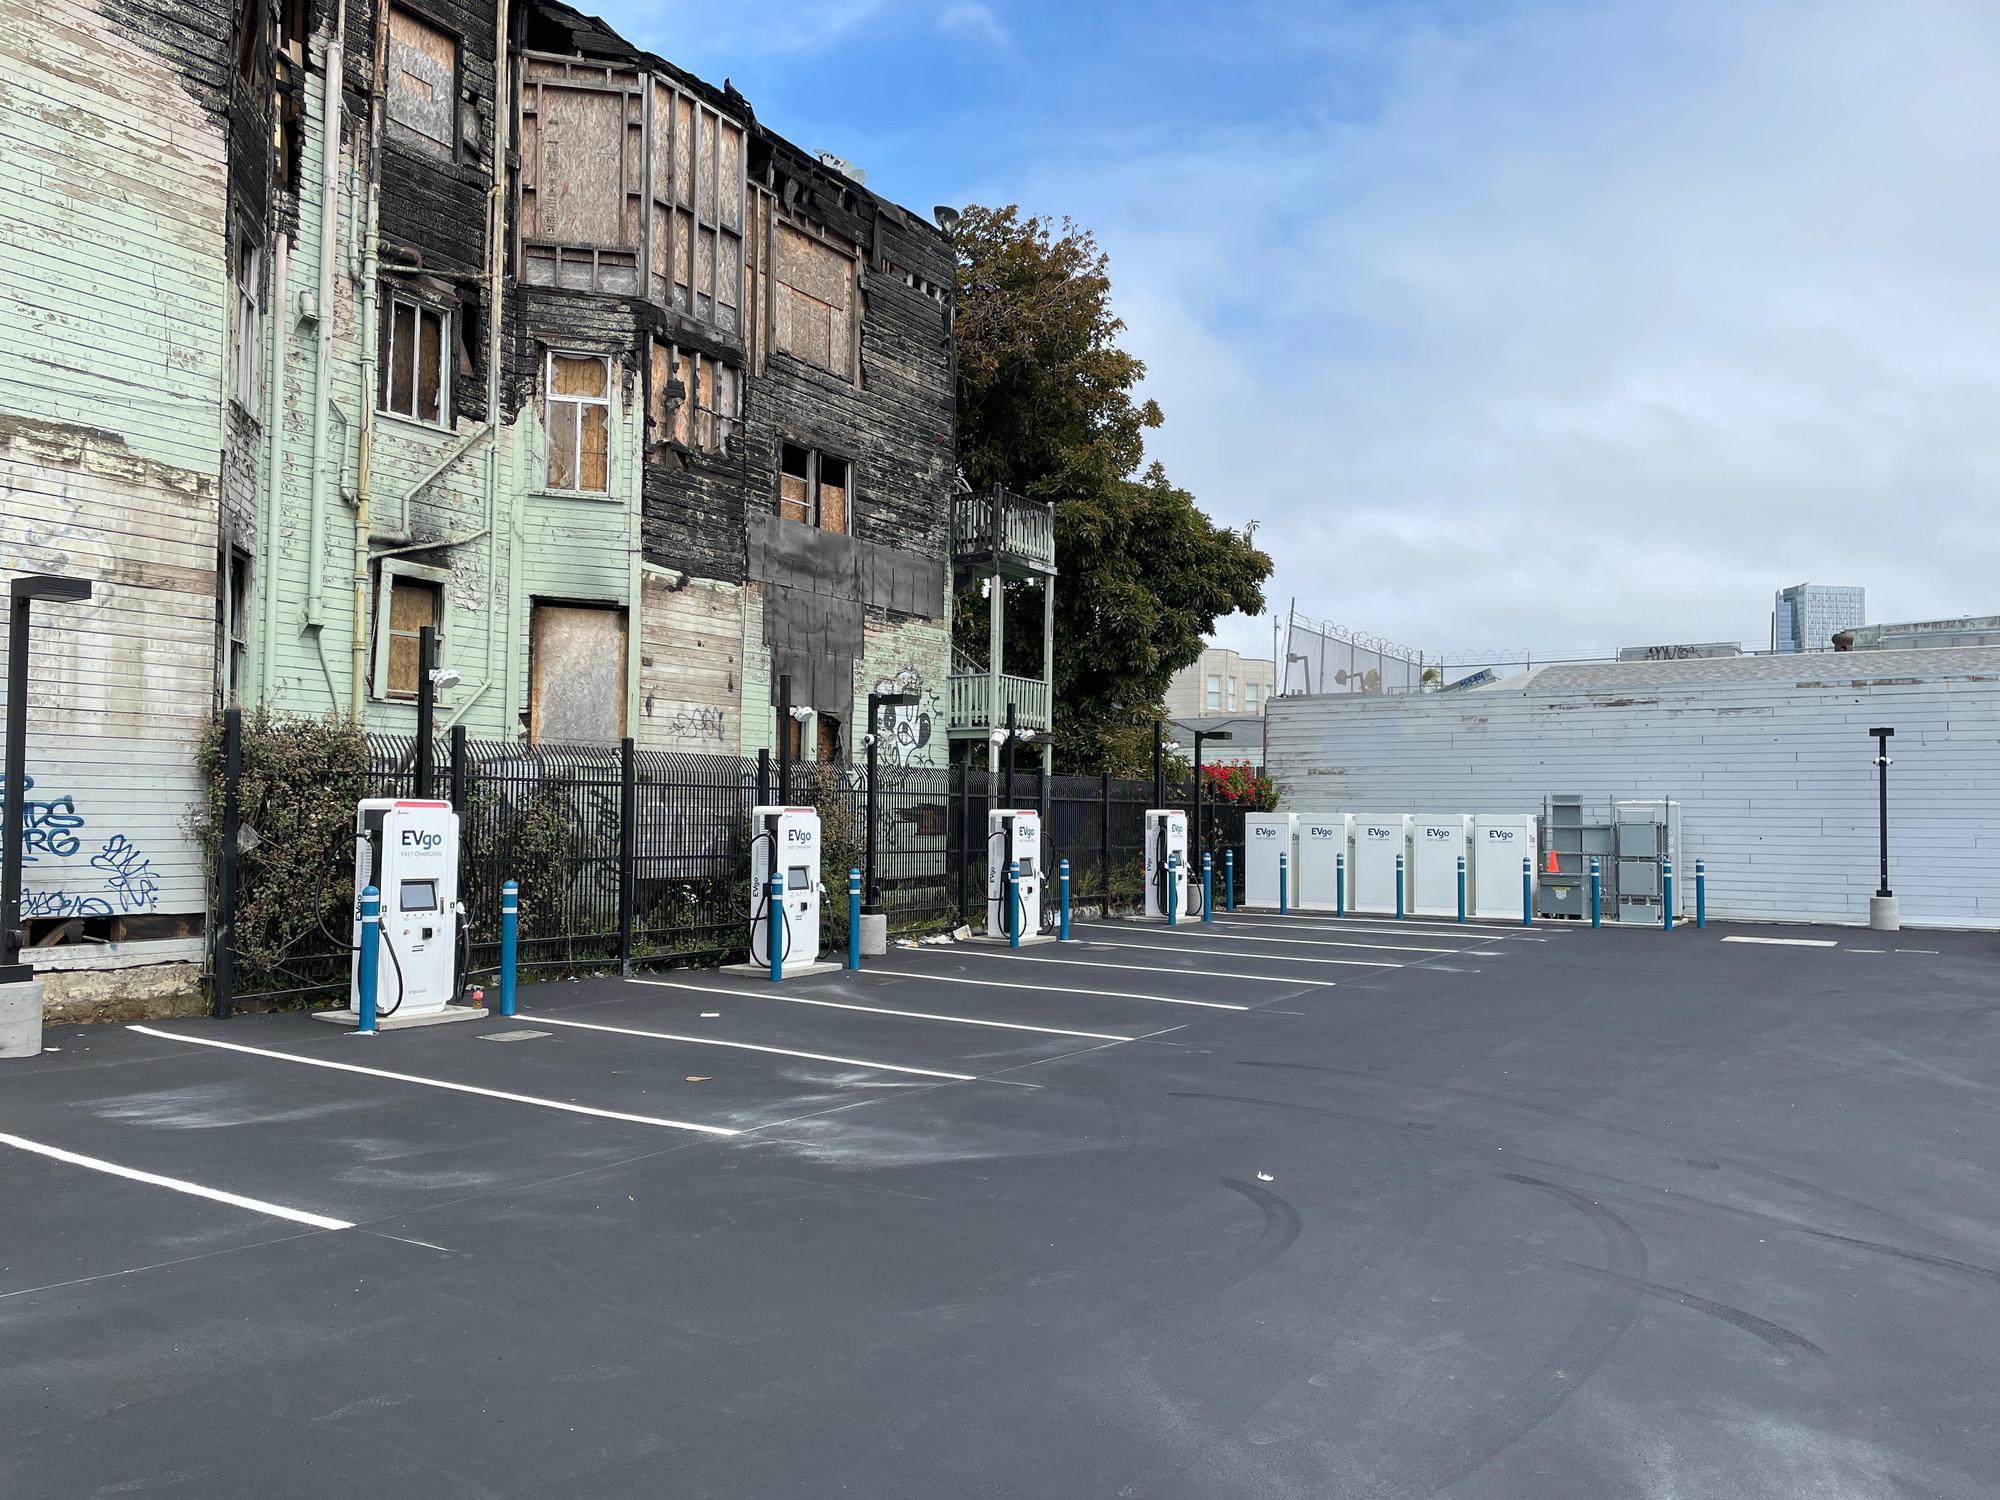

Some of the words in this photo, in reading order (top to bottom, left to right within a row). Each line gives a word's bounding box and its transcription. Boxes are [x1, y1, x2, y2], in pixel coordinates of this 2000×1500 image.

[788, 830, 812, 844] EVgo
[1019, 826, 1035, 838] EVgo
[1255, 828, 1276, 837] EVgo
[1311, 828, 1332, 838] EVgo
[1368, 828, 1390, 838] EVgo
[1426, 829, 1450, 838] EVgo
[1489, 830, 1514, 840] EVgo
[402, 830, 442, 850] EVgo
